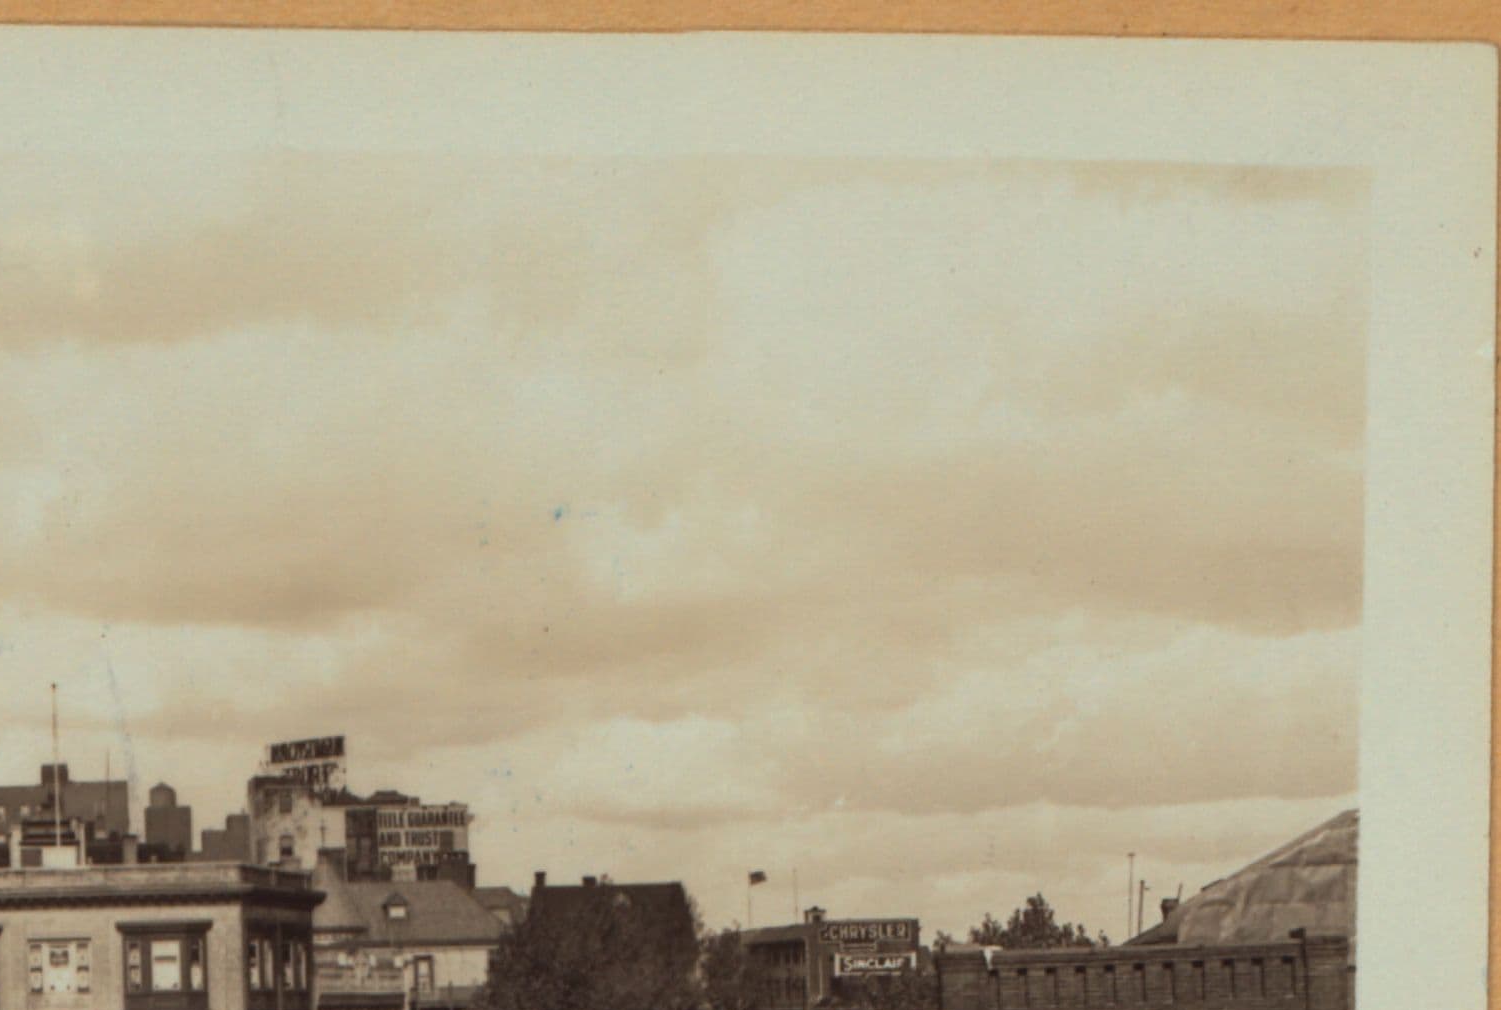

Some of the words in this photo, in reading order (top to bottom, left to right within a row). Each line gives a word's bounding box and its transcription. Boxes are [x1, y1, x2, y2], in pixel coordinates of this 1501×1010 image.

[379, 811, 405, 828] TITLE
[409, 810, 465, 826] GUARANTEE
[379, 831, 402, 847] AND
[405, 830, 439, 846] TRUST
[830, 925, 906, 939] CHRYSLER
